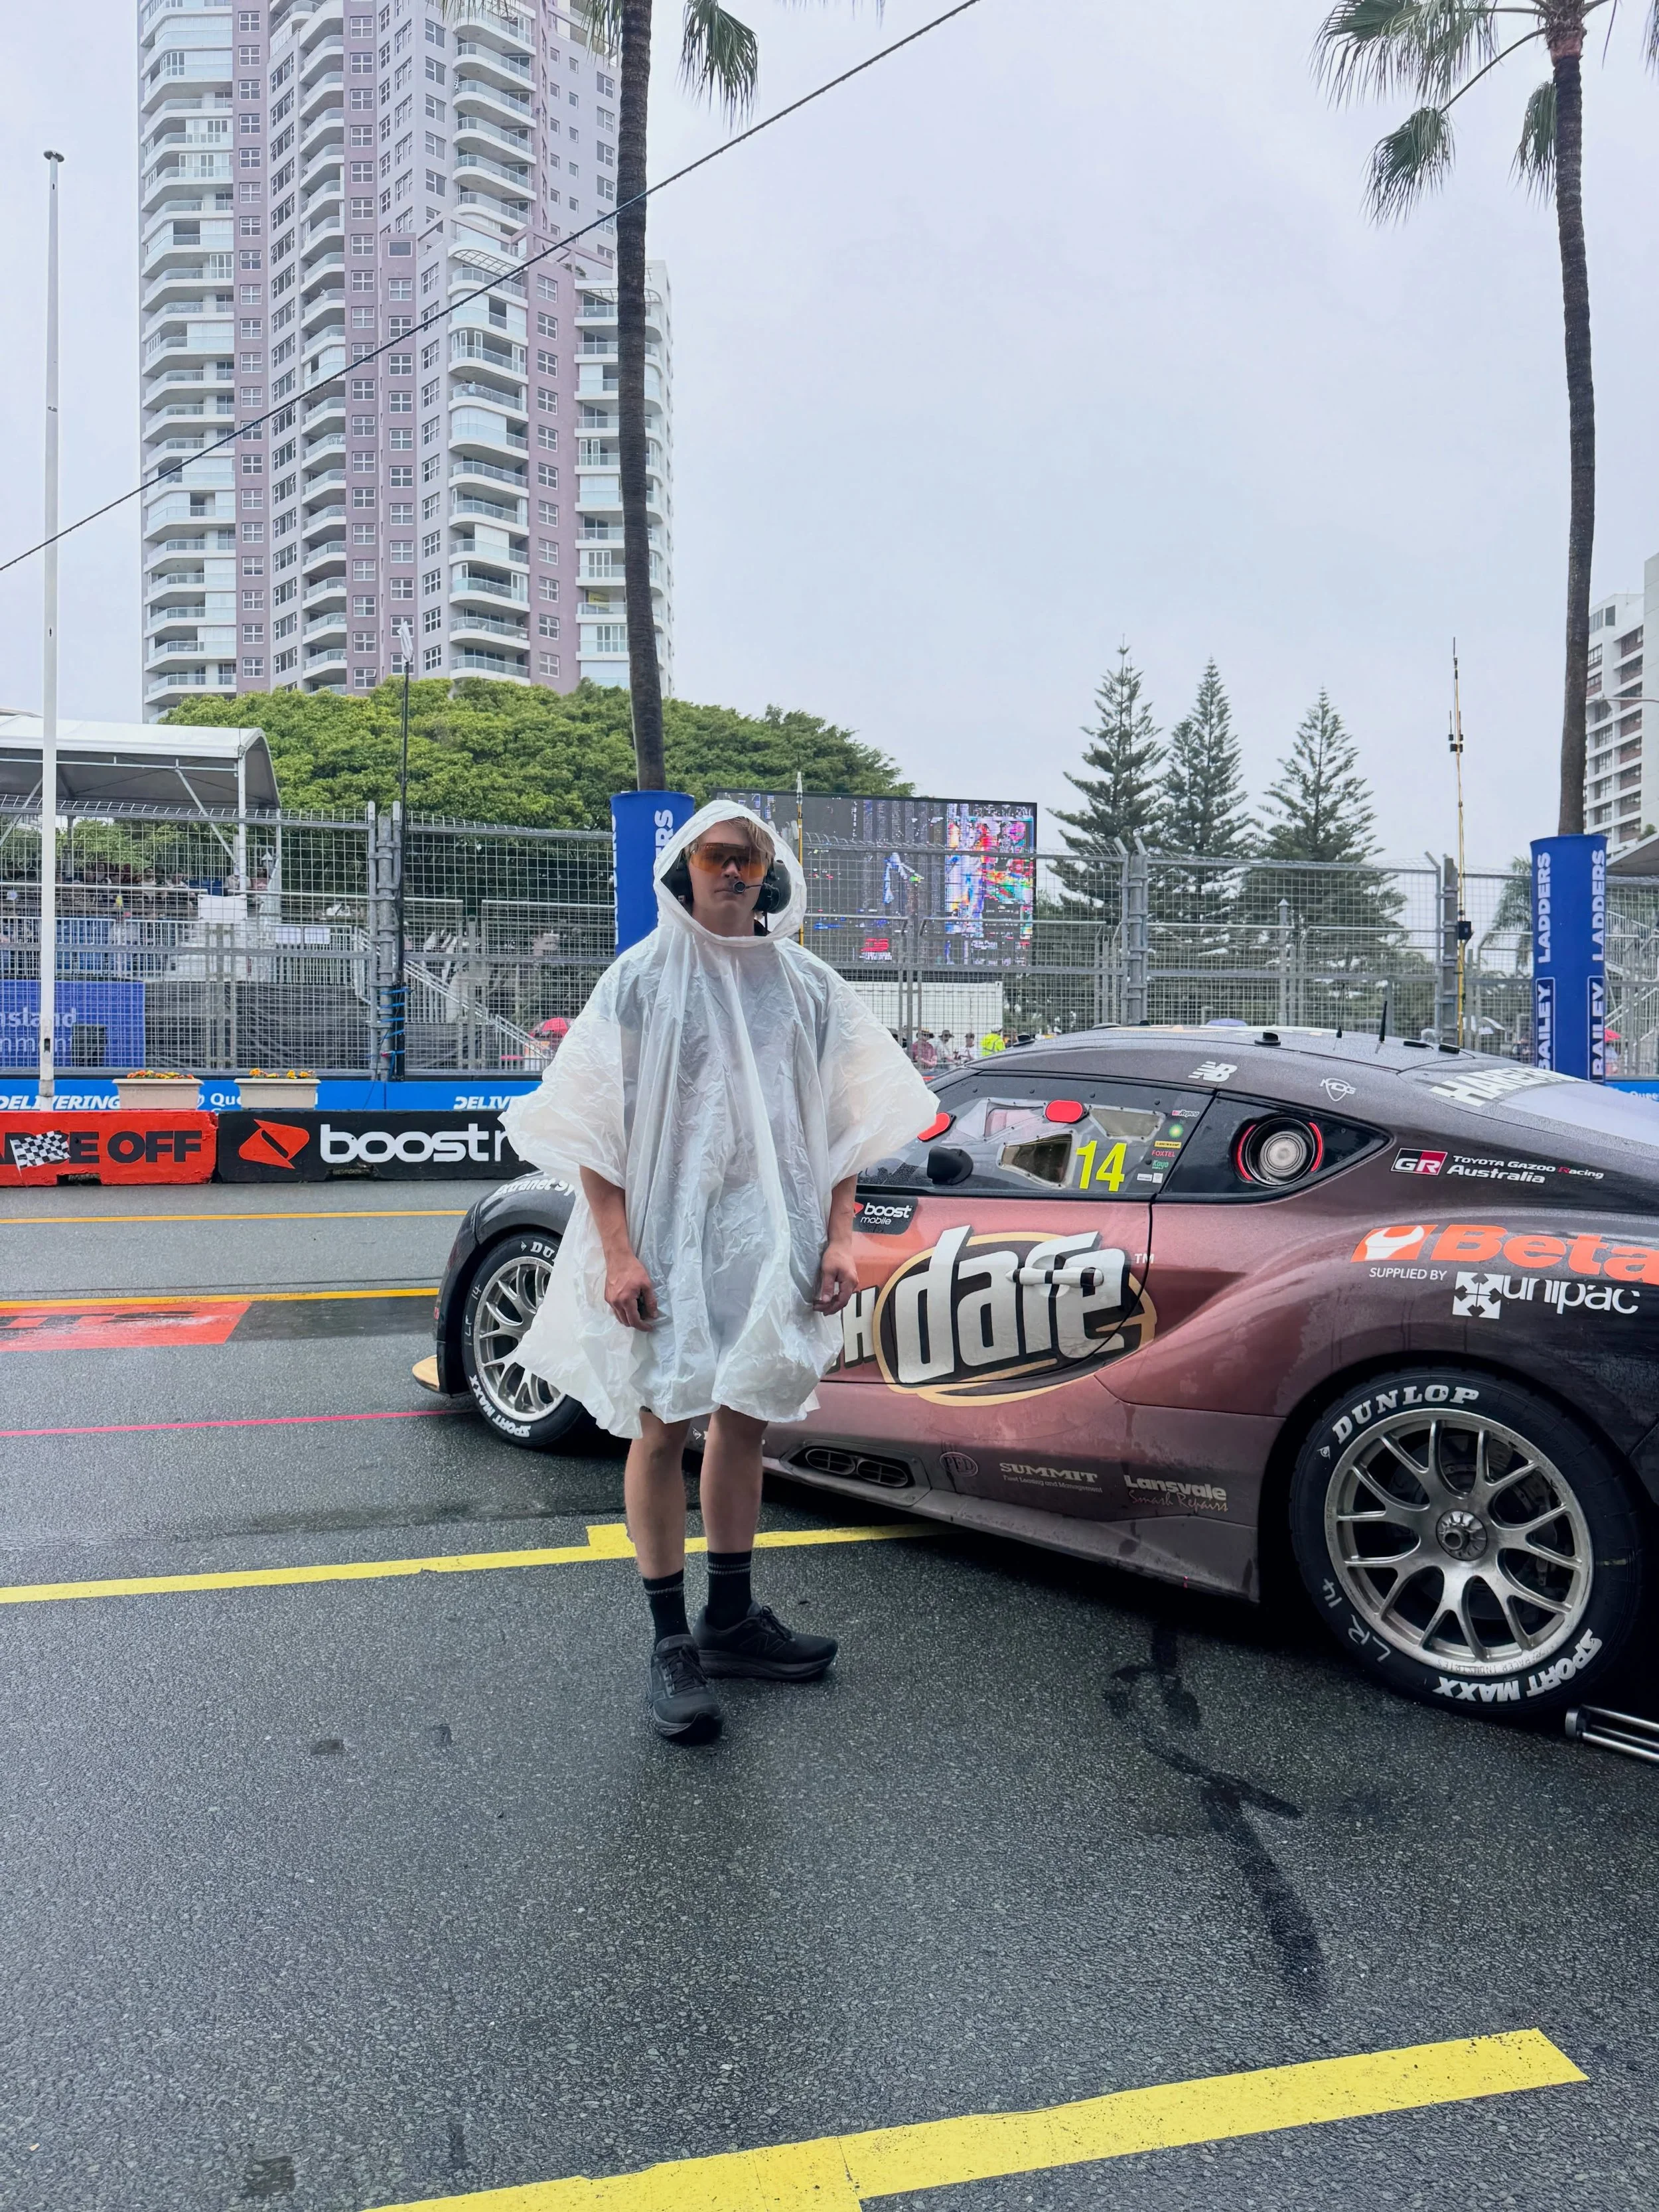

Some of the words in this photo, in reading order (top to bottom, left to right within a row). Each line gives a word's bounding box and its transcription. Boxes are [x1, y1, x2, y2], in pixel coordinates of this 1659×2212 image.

[1537, 851, 1551, 964] LADDERS
[1591, 849, 1605, 961] LADDERS
[1592, 982, 1604, 1076] BAILEY
[107, 1130, 202, 1164] OFF
[320, 1123, 489, 1163] boost
[1076, 1140, 1127, 1192] 14
[1394, 1157, 1441, 1174] GR
[1447, 1165, 1546, 1184] Australia
[1453, 1155, 1504, 1168] TOYOTA
[1507, 1161, 1556, 1173] GAZOO
[1557, 1166, 1605, 1180] Racing
[861, 1217, 892, 1225] mobile
[864, 1202, 912, 1218] boost
[1430, 1224, 1659, 1286] Beta
[1369, 1267, 1427, 1280] SUPPLIED
[1429, 1270, 1447, 1282] BY
[471, 1284, 482, 1300] 14
[1502, 1276, 1640, 1315] unipac
[469, 1374, 496, 1418] MAXX
[492, 1414, 532, 1438] SPORT
[1332, 1384, 1479, 1445] DUNLOP
[999, 1462, 1098, 1483] SUMMIT
[1123, 1475, 1227, 1501] Lansvale
[1128, 1489, 1173, 1506] Smash
[1177, 1493, 1229, 1512] Repairs
[1323, 1578, 1342, 1608] 14
[1526, 1628, 1603, 1698] SPORT
[1432, 1676, 1522, 1703] MAXX
